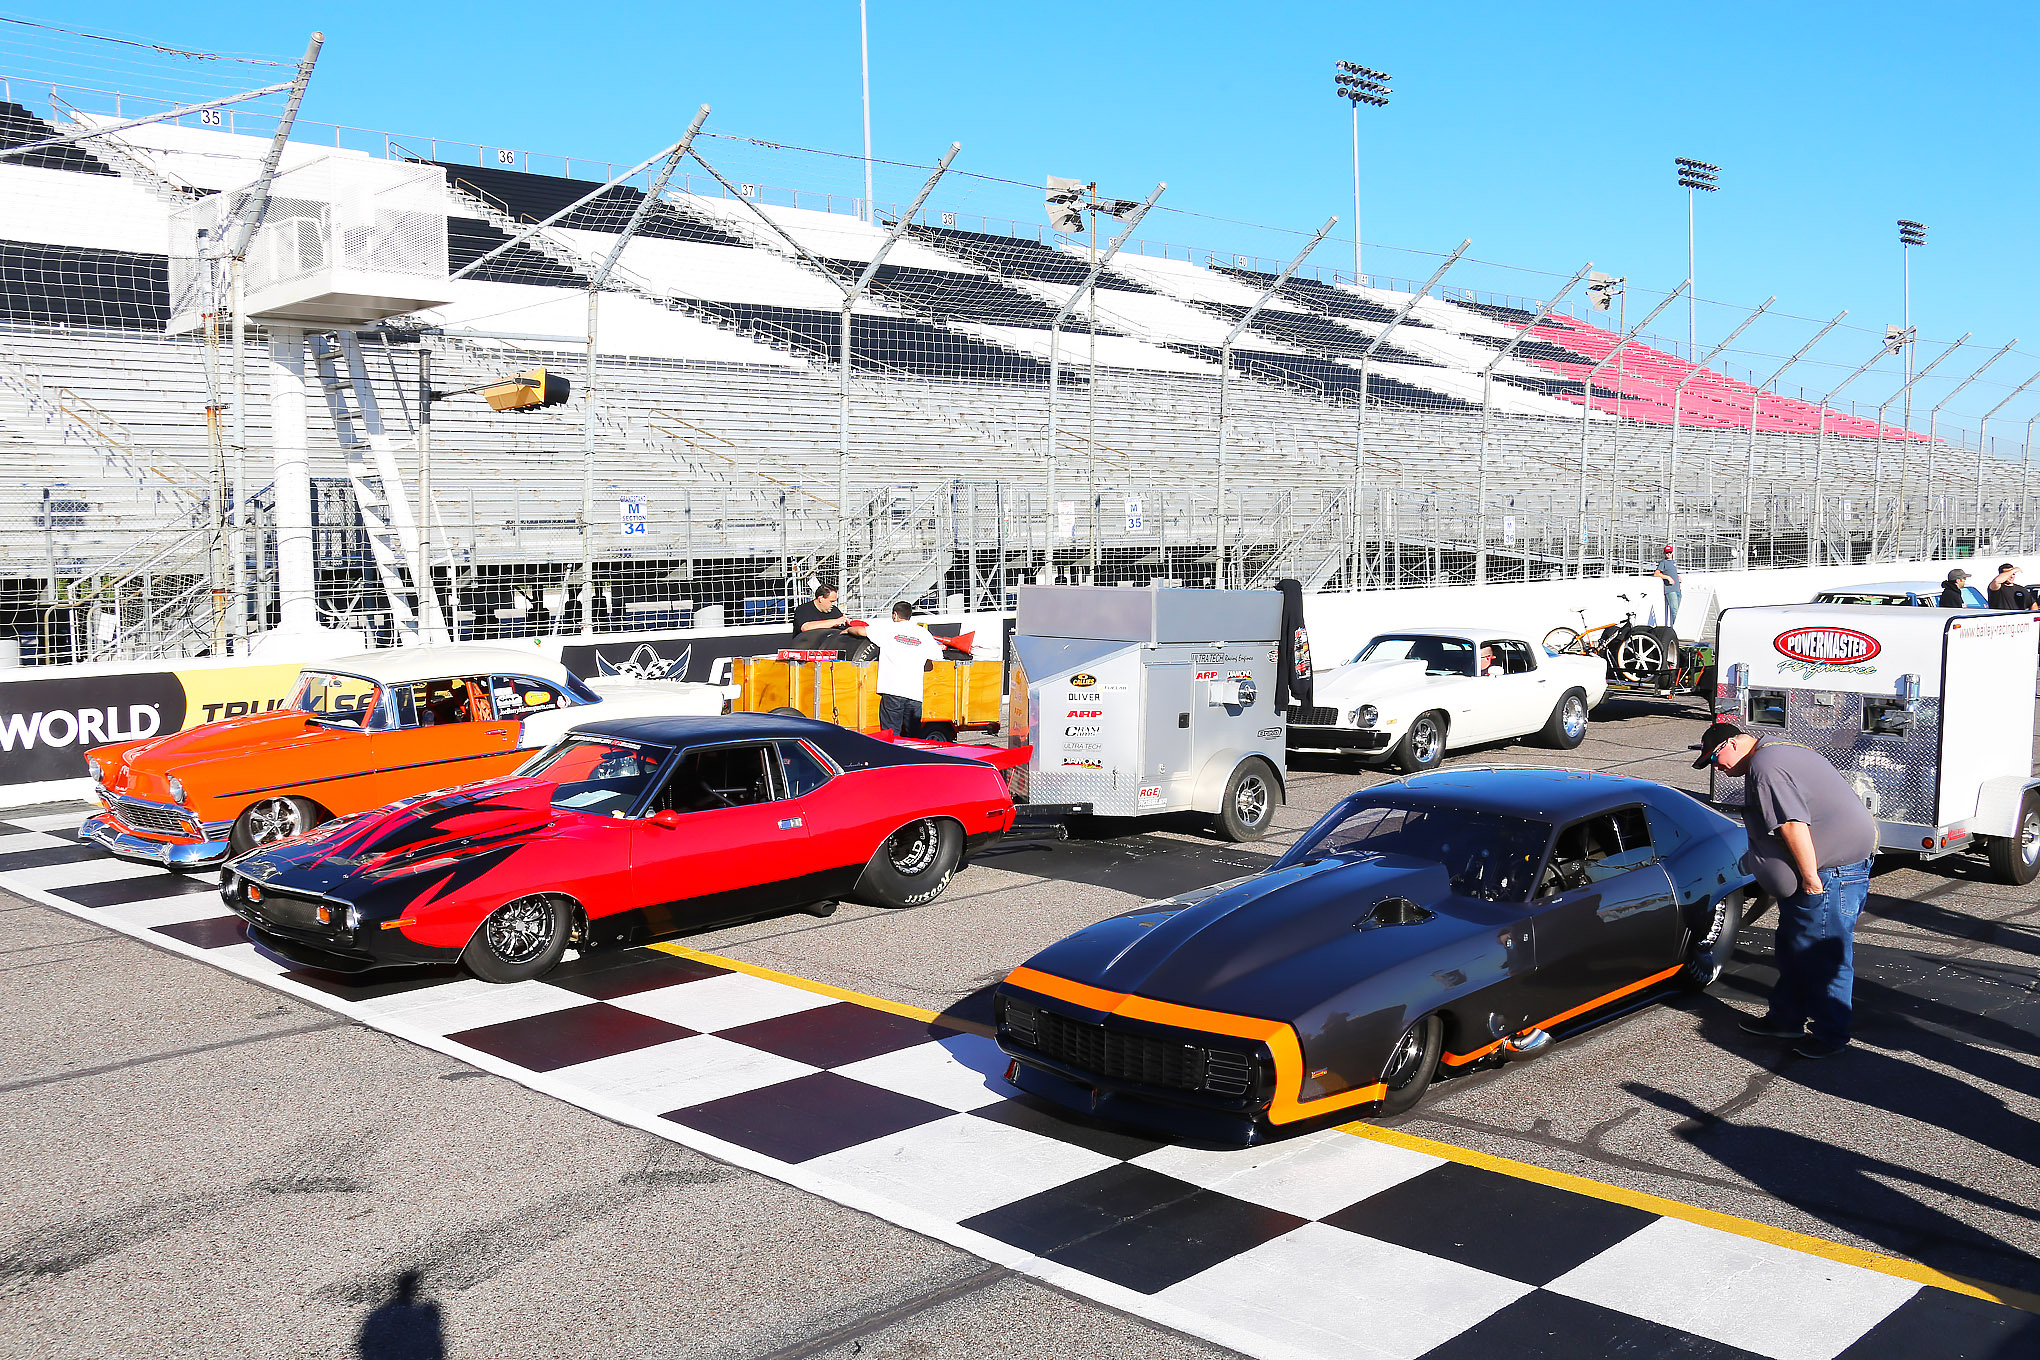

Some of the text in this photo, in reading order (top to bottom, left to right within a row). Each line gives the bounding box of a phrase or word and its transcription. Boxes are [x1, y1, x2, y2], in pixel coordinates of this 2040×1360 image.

[202, 109, 220, 125] 35
[499, 150, 514, 164] 36
[742, 184, 754, 196] 37
[628, 503, 640, 514] M
[1130, 504, 1138, 513] M
[624, 522, 646, 535] 34
[1128, 518, 1142, 529] 35
[1505, 534, 1515, 544] 36
[1787, 631, 1867, 659] POWERMASTER
[1777, 659, 1877, 680] Performance
[1196, 671, 1218, 680] ARP
[1068, 693, 1100, 701] OLIVER
[1066, 710, 1103, 718] ARP
[0, 704, 161, 751] WORLD
[1063, 757, 1102, 766] DIAMOND
